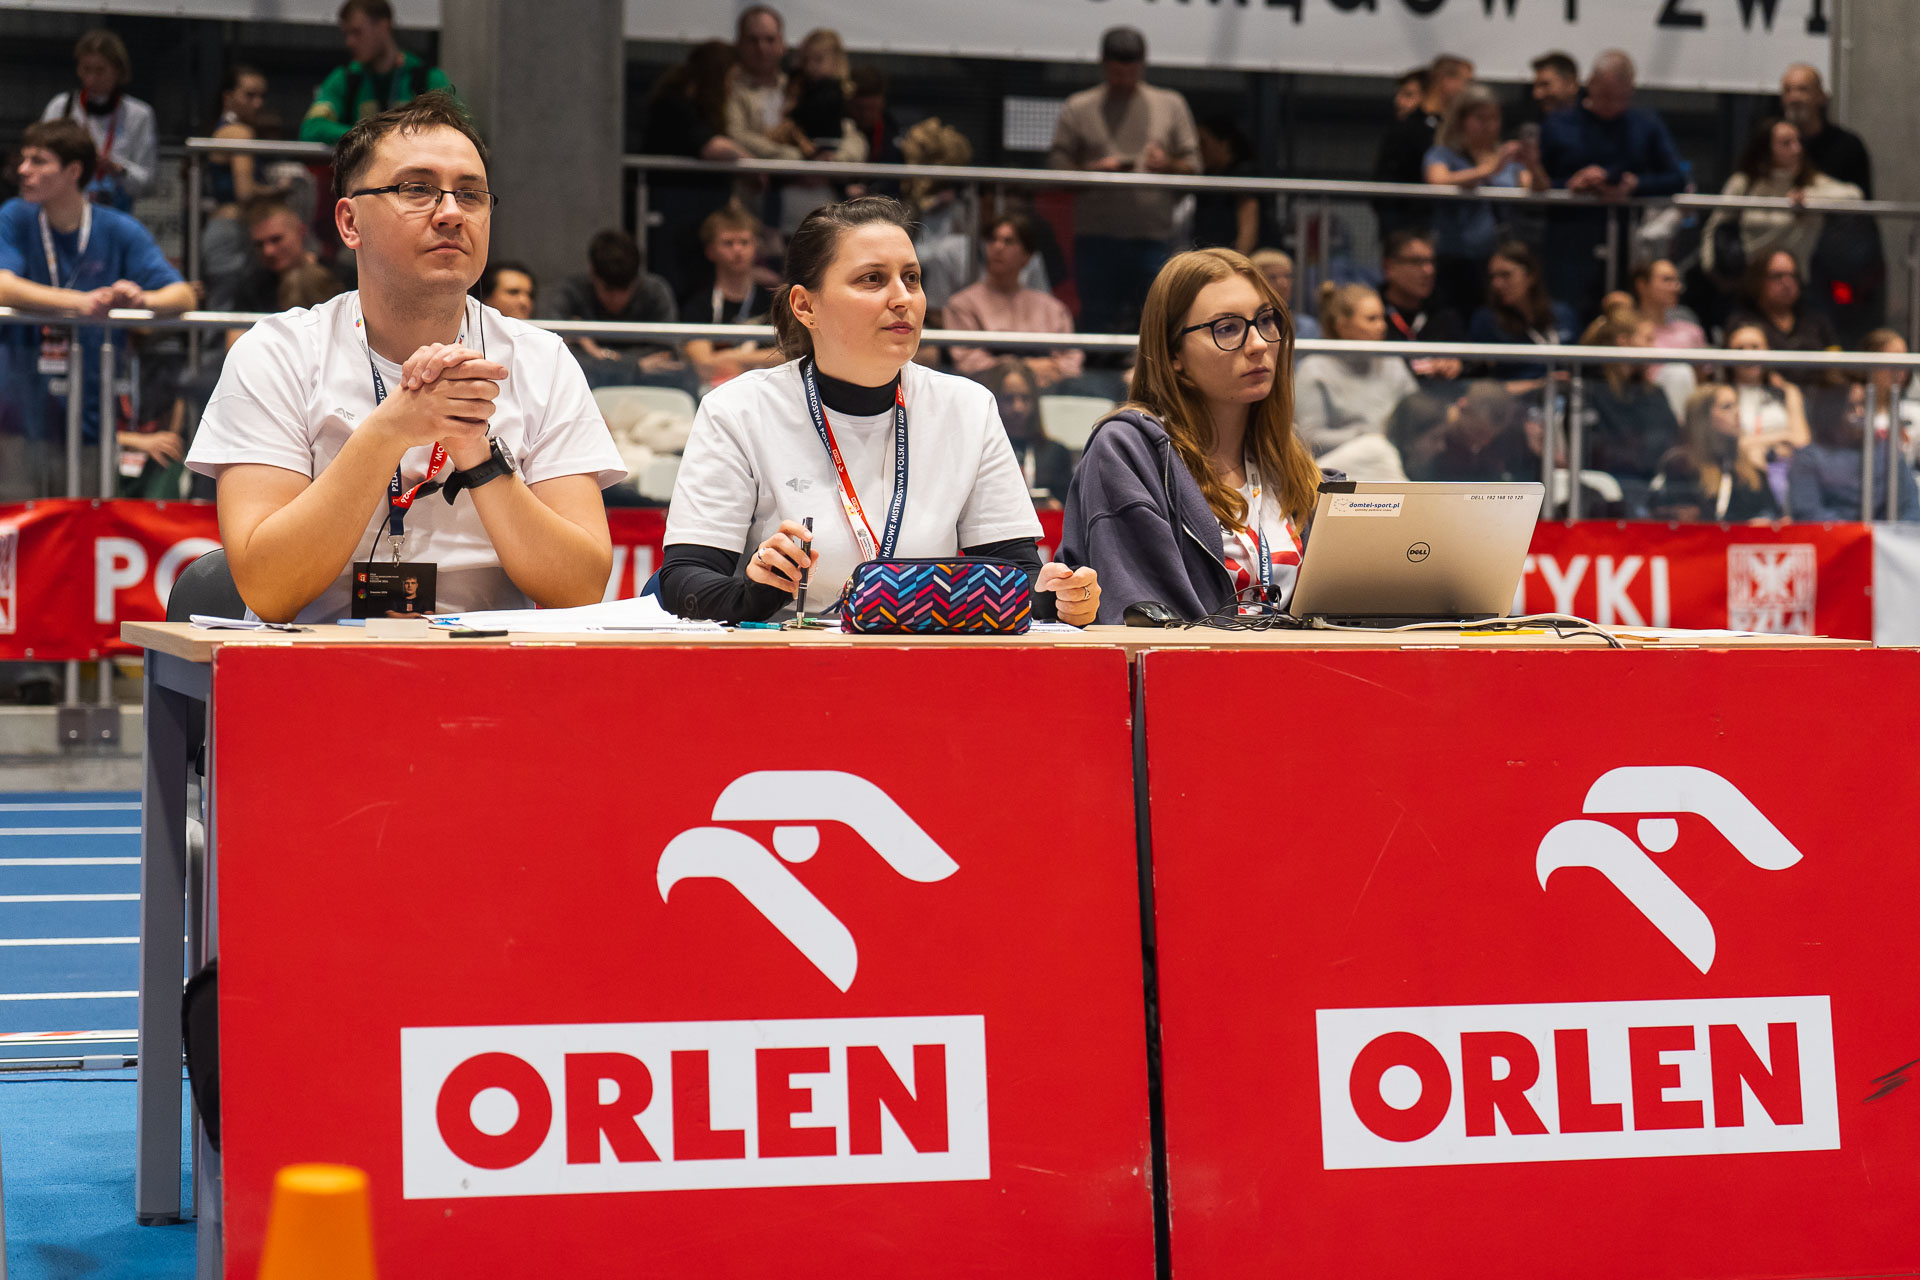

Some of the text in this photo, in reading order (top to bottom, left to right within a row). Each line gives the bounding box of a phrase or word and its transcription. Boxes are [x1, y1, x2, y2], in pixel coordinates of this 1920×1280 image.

[807, 377, 823, 427] MISTRZOSTWA
[897, 409, 905, 424] U20
[897, 428, 905, 443] U18
[897, 444, 905, 470] POLSKI
[891, 472, 905, 524] MISTRZOSTWA
[1349, 502, 1400, 510] domtel-sport.pl
[882, 523, 897, 558] HALOWE
[1349, 1022, 1803, 1142] ORLEN
[436, 1044, 949, 1170] ORLEN
